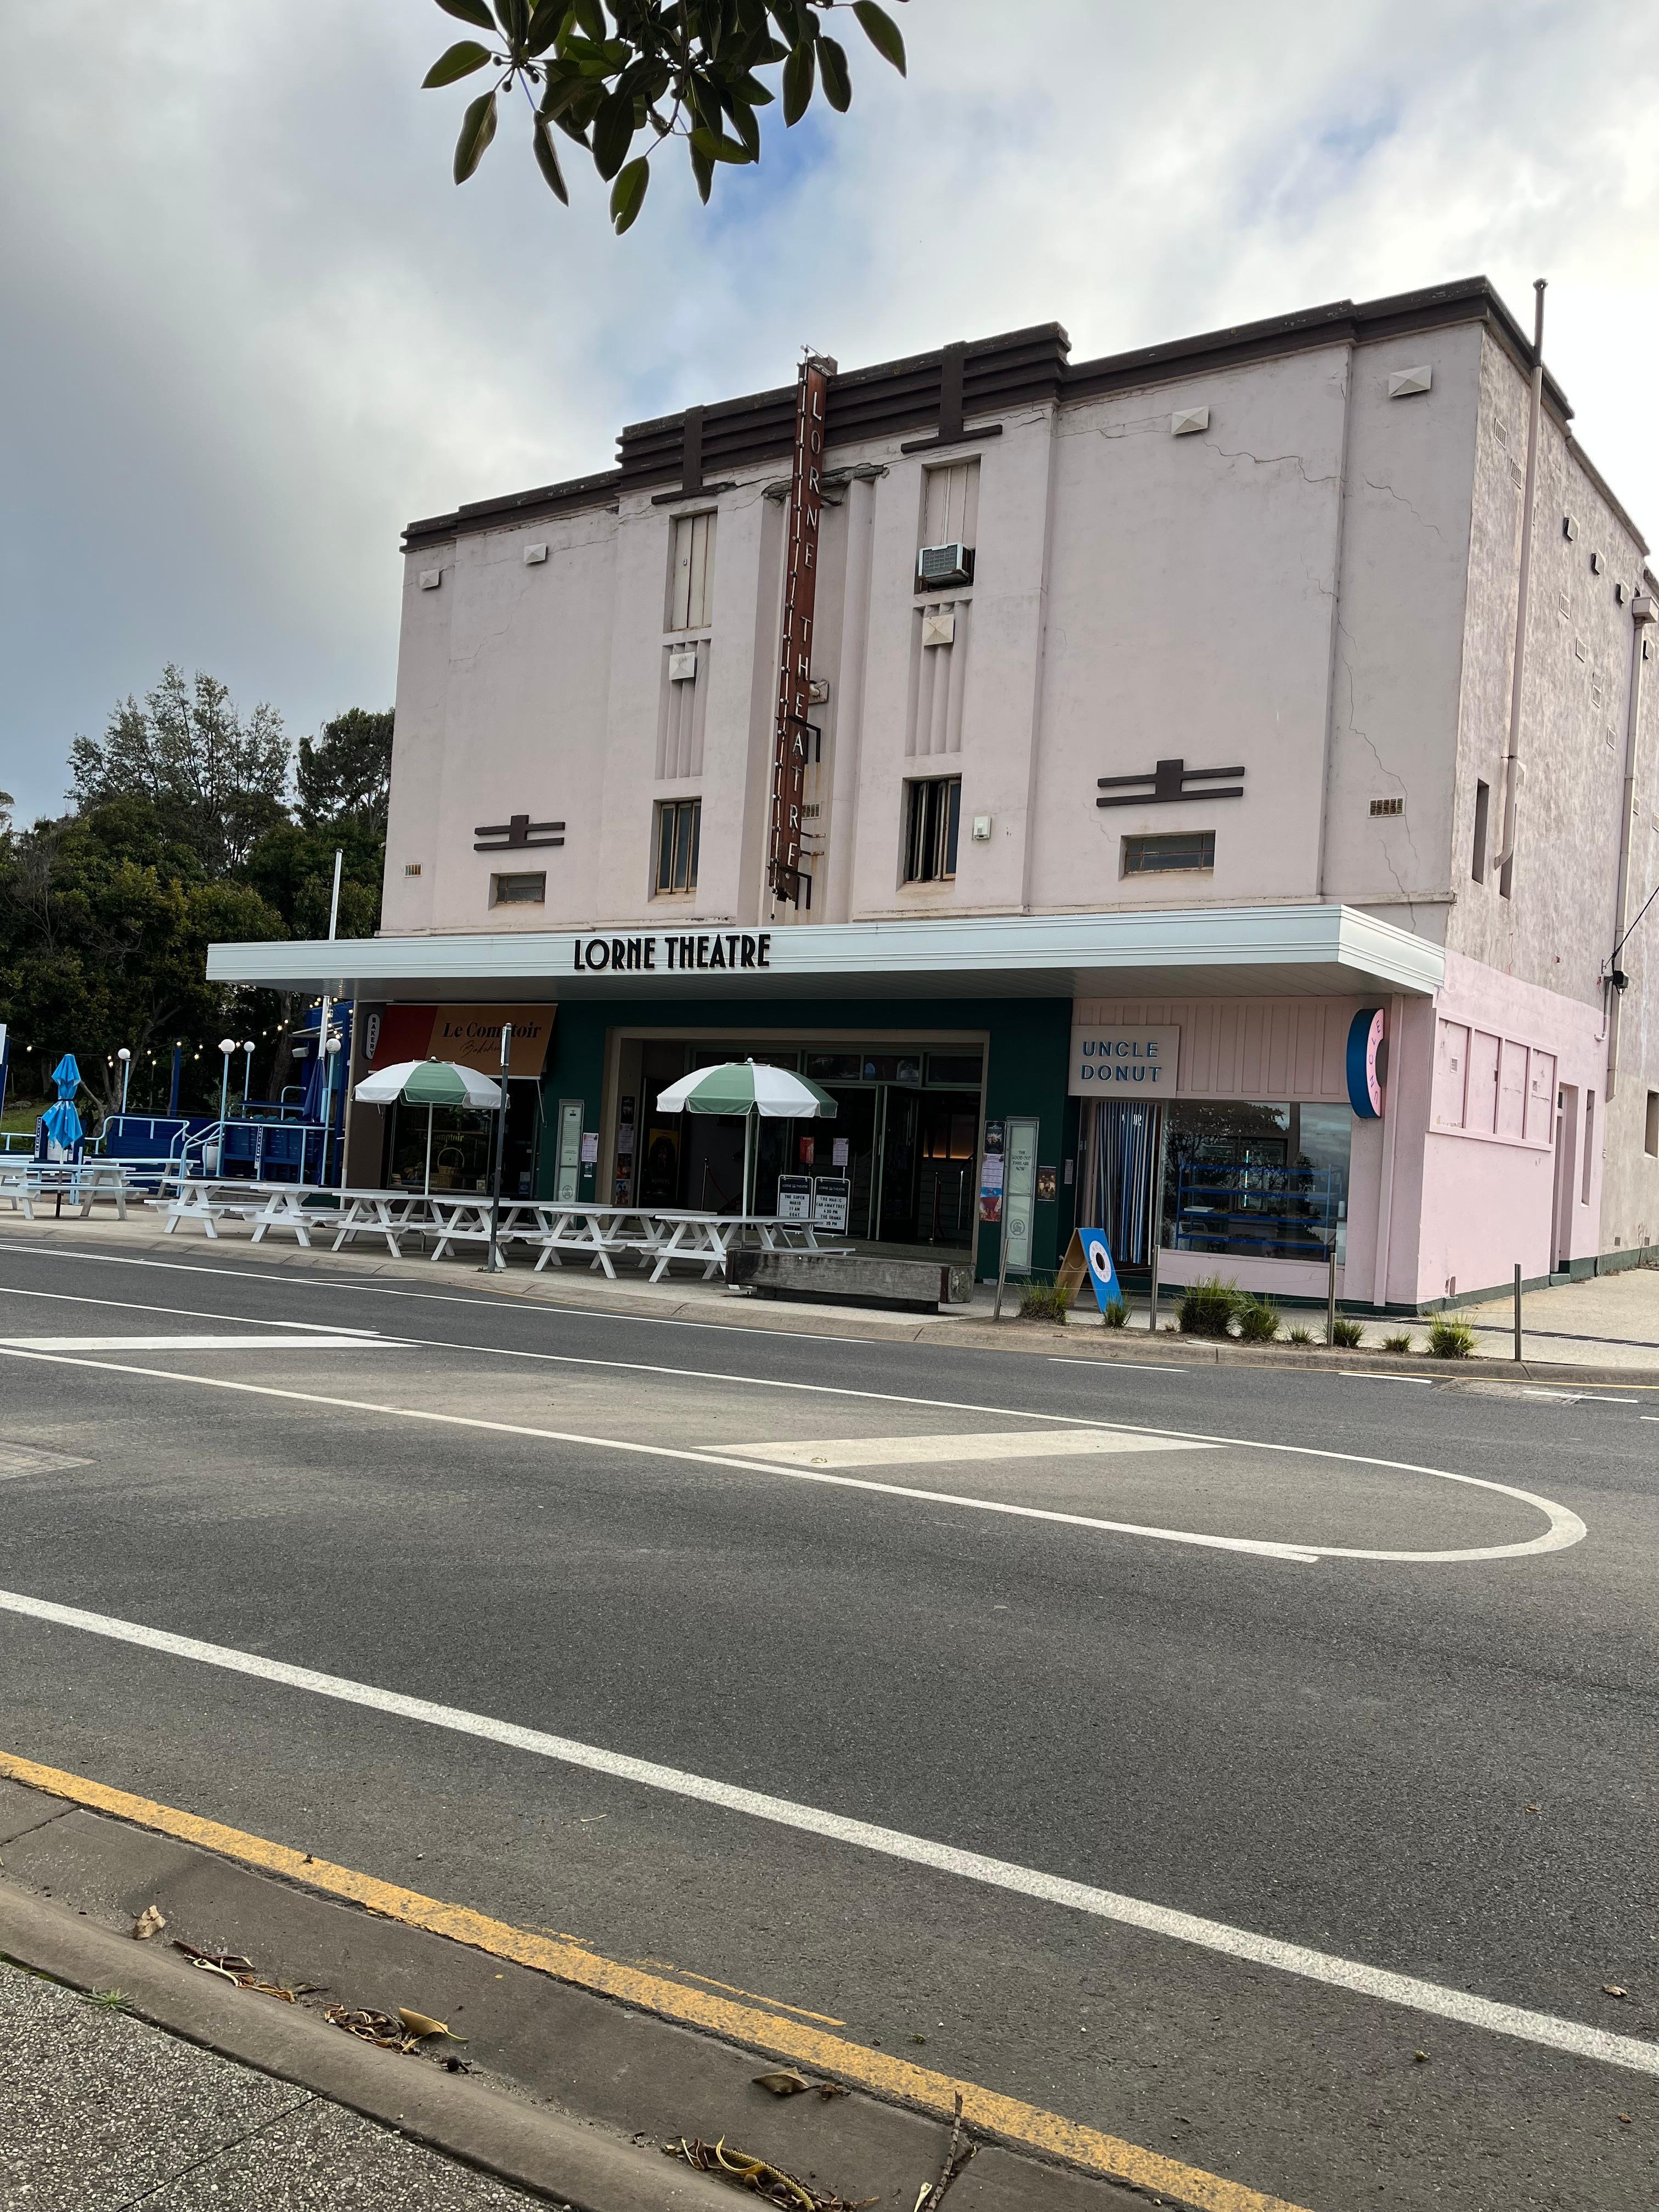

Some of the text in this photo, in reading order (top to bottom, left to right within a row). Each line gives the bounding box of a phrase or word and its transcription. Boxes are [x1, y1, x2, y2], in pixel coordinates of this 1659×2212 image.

[787, 391, 822, 867] LORNE THEATRE
[574, 934, 771, 970] LORNE THEATRE
[442, 1021, 541, 1042] Le Comtoir
[460, 1040, 501, 1059] Bakehou
[1082, 1041, 1159, 1058] UNCLE
[1369, 1020, 1380, 1105] UNCLE
[1081, 1064, 1162, 1082] DONUT
[432, 1132, 465, 1143] omptoir
